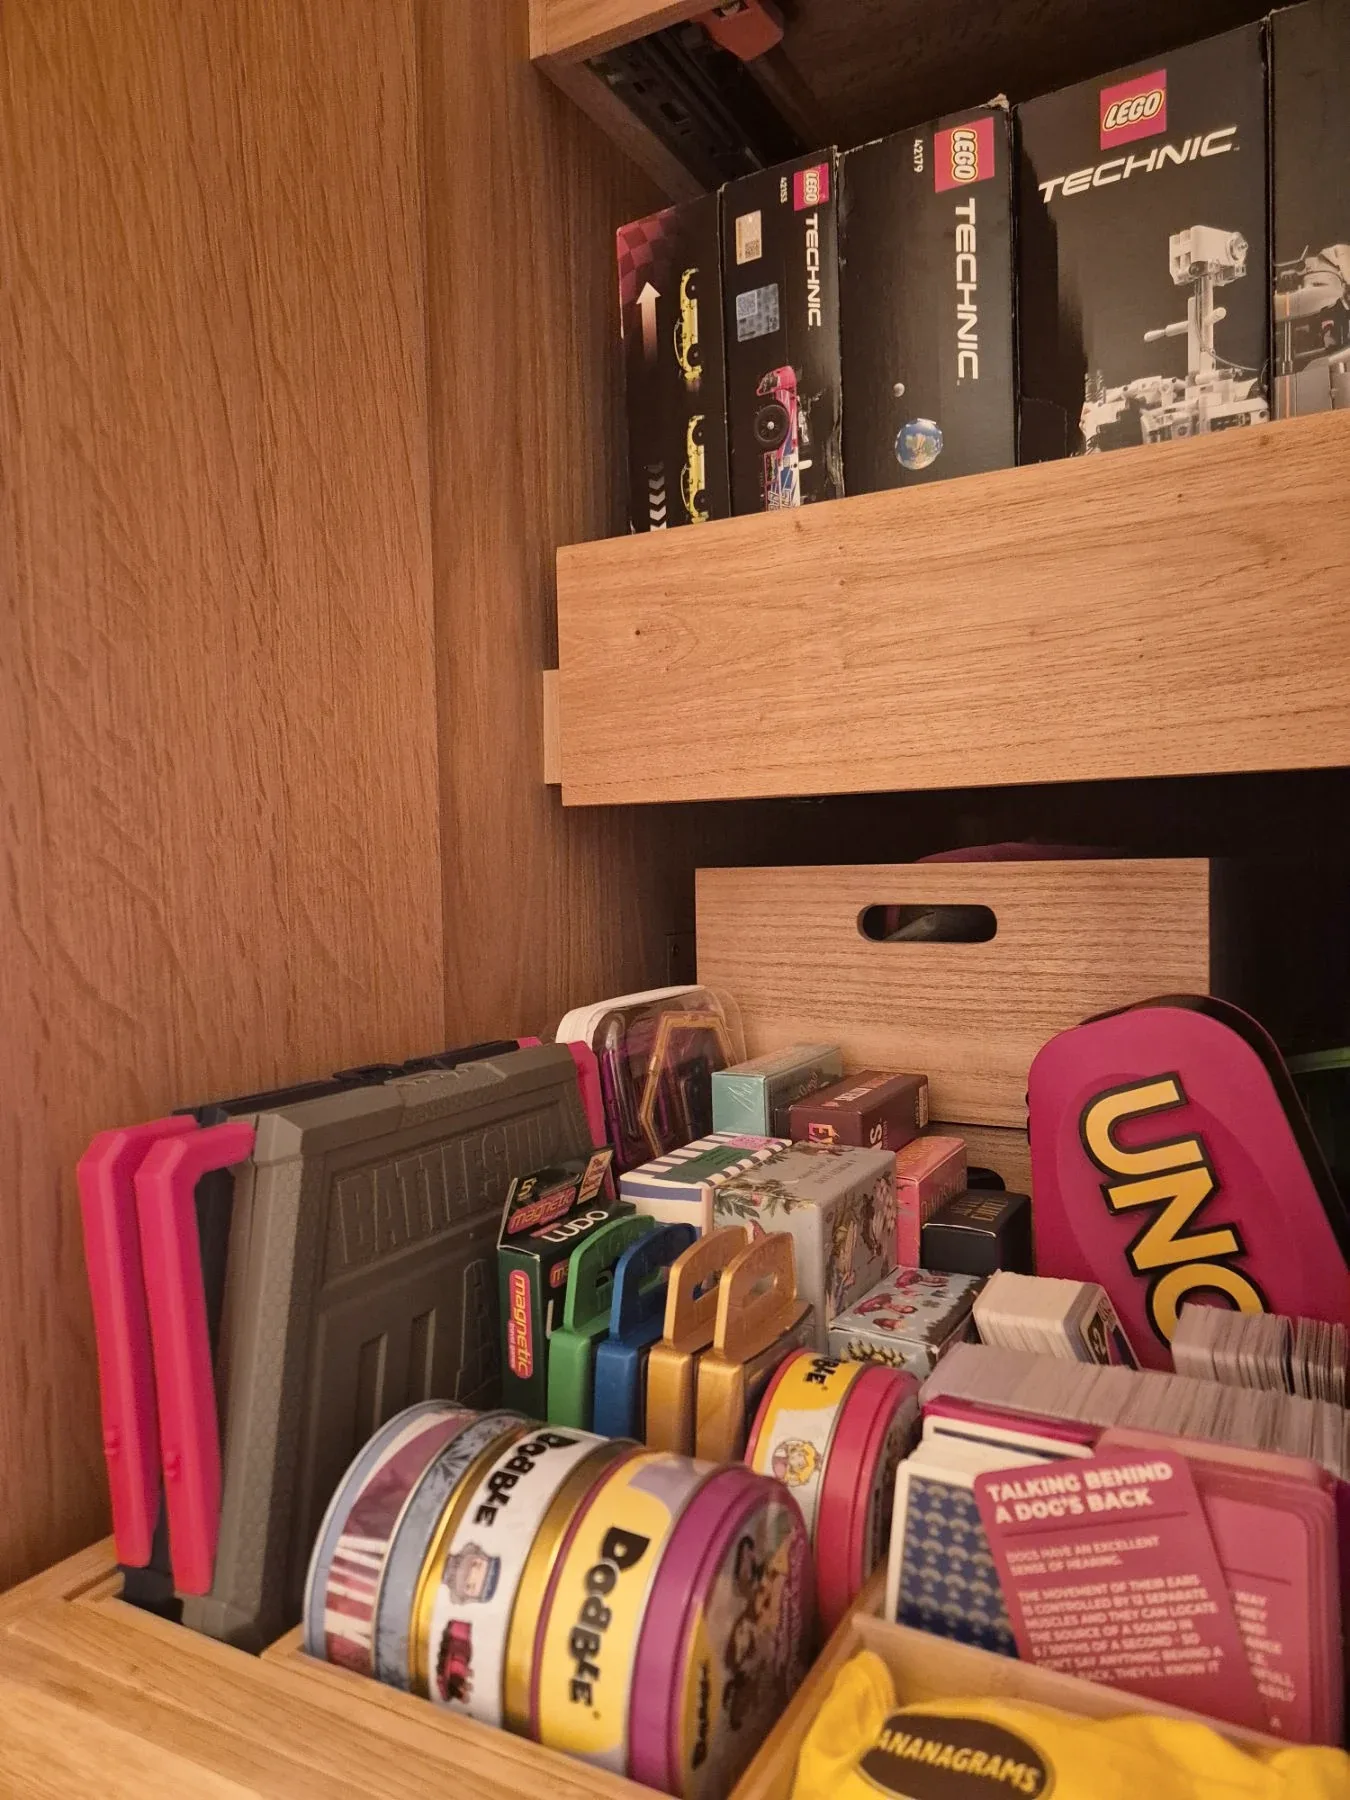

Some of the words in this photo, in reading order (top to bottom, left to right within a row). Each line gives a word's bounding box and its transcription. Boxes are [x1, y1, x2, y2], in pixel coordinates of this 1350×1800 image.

[1103, 89, 1164, 131] LEGO
[950, 128, 978, 181] LEGO
[1038, 127, 1237, 203] TECHNIC
[804, 171, 819, 206] LEGO
[806, 213, 822, 327] TECHNIC
[955, 198, 979, 379] TECHNIC
[542, 1210, 609, 1243] LUDO
[1080, 1073, 1267, 1346] UNO
[513, 1273, 531, 1377] magnetic
[985, 1473, 1081, 1502] TALKING
[1083, 1461, 1173, 1490] BEHIND
[996, 1505, 1013, 1524] A
[1014, 1495, 1084, 1521] DOG'S
[1087, 1487, 1153, 1512] BACK
[1092, 1535, 1160, 1553] EXCELLENT
[878, 1728, 1042, 1793] ANANAGRAMS
